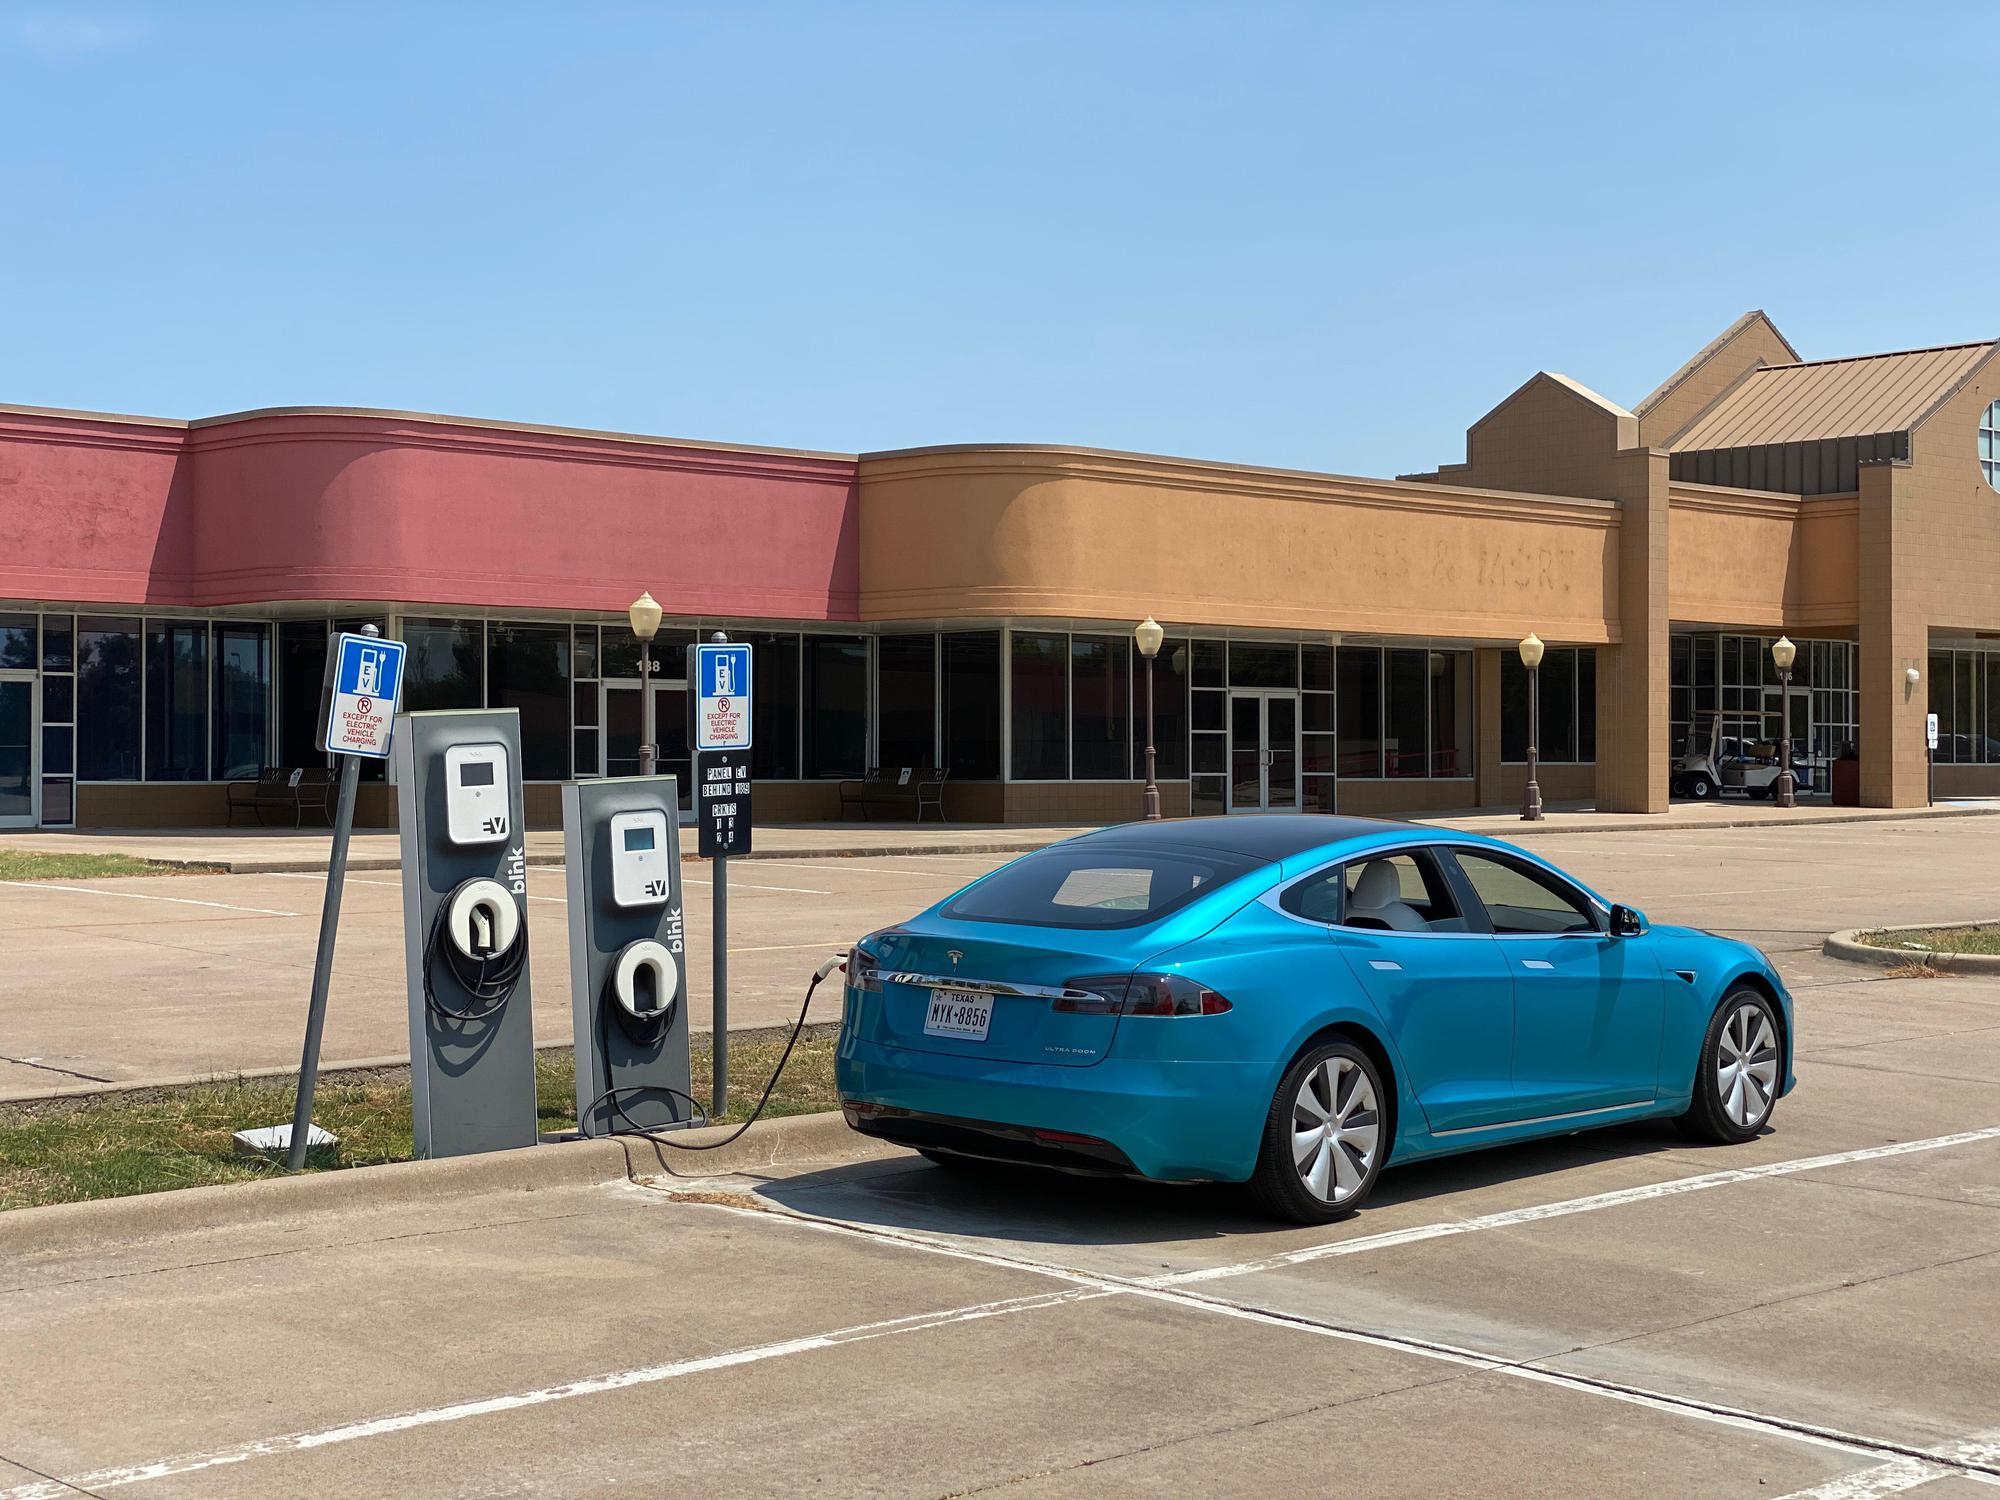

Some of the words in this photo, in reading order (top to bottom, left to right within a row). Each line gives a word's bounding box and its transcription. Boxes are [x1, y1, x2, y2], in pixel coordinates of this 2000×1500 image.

[343, 712, 368, 721] EXCEPT
[369, 715, 383, 723] FOR
[346, 720, 377, 730] ELECTRIC
[347, 728, 374, 738] VEHICLE
[342, 735, 377, 746] CHARGING
[708, 767, 732, 780] PANEL
[736, 766, 746, 778] EV
[703, 783, 732, 796] BEHIND
[507, 846, 525, 894] blink
[667, 907, 683, 953] blink
[951, 993, 975, 1003] TEXAS
